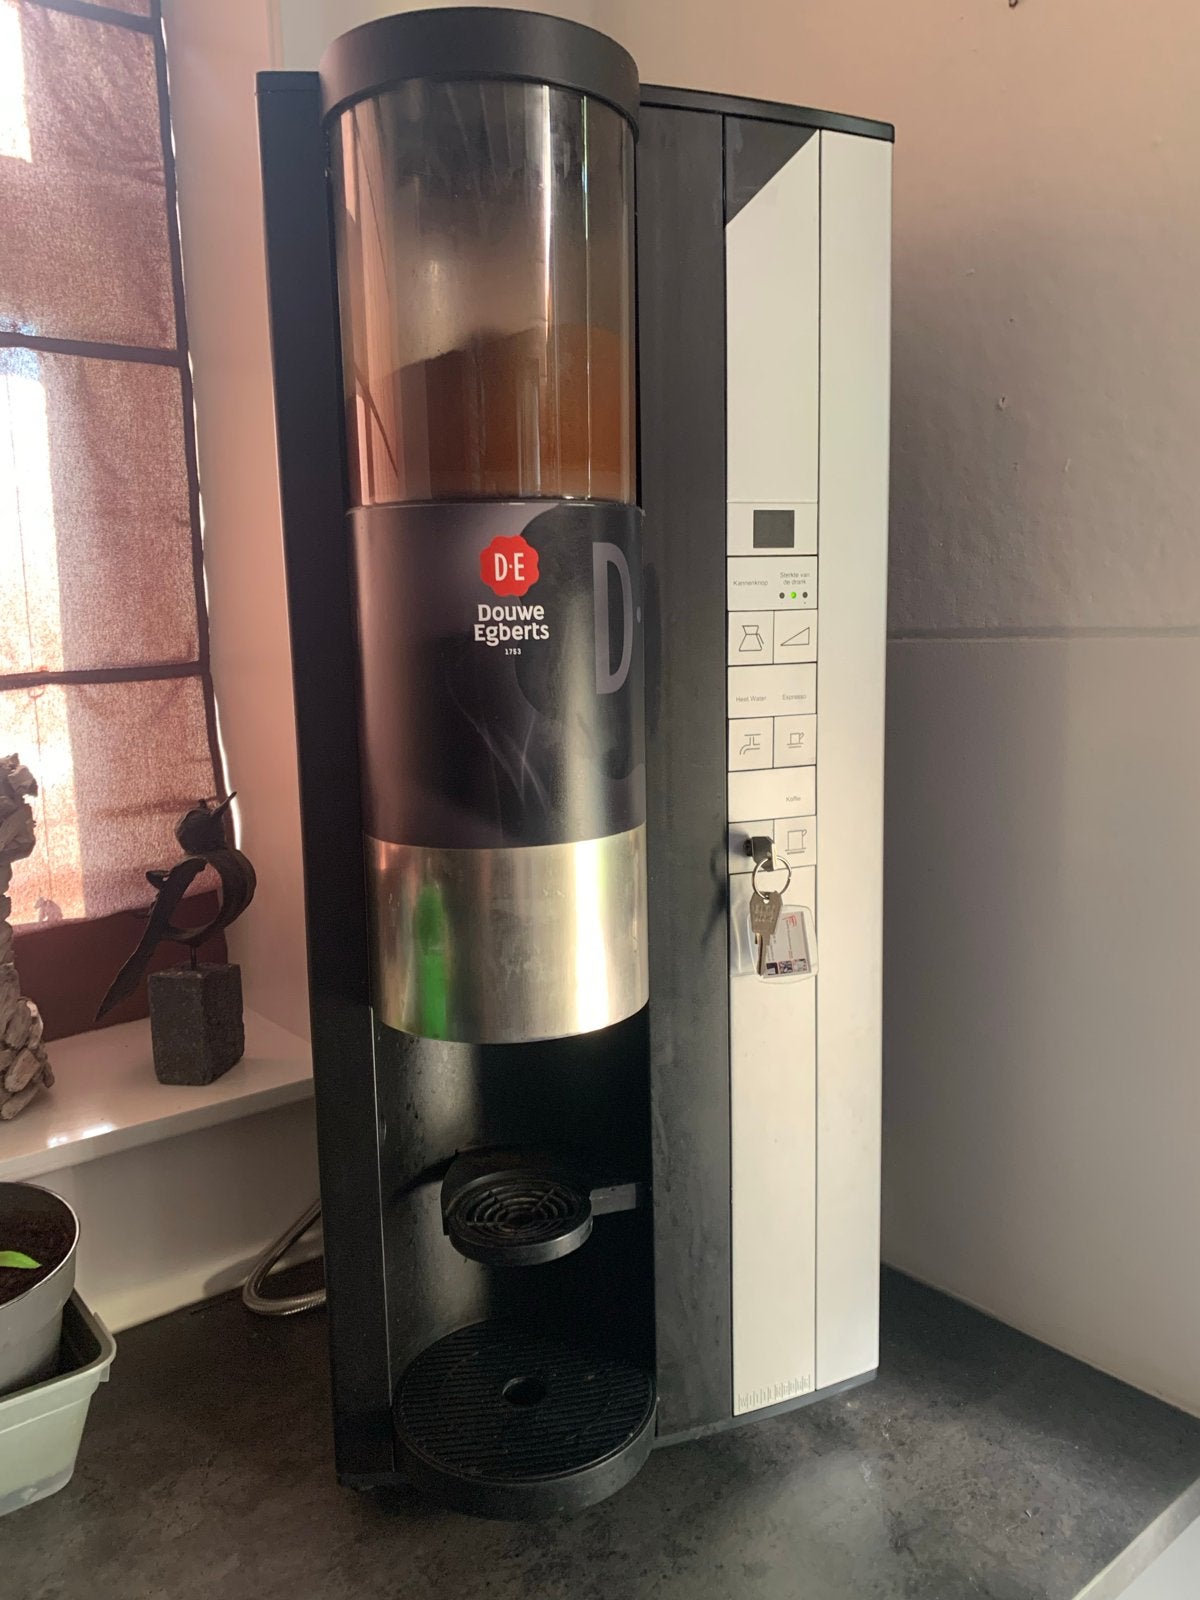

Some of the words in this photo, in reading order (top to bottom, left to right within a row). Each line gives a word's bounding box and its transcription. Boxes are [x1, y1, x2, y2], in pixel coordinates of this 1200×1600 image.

[477, 604, 545, 622] Douwe
[474, 622, 550, 647] Egberts
[504, 648, 522, 656] 1753
